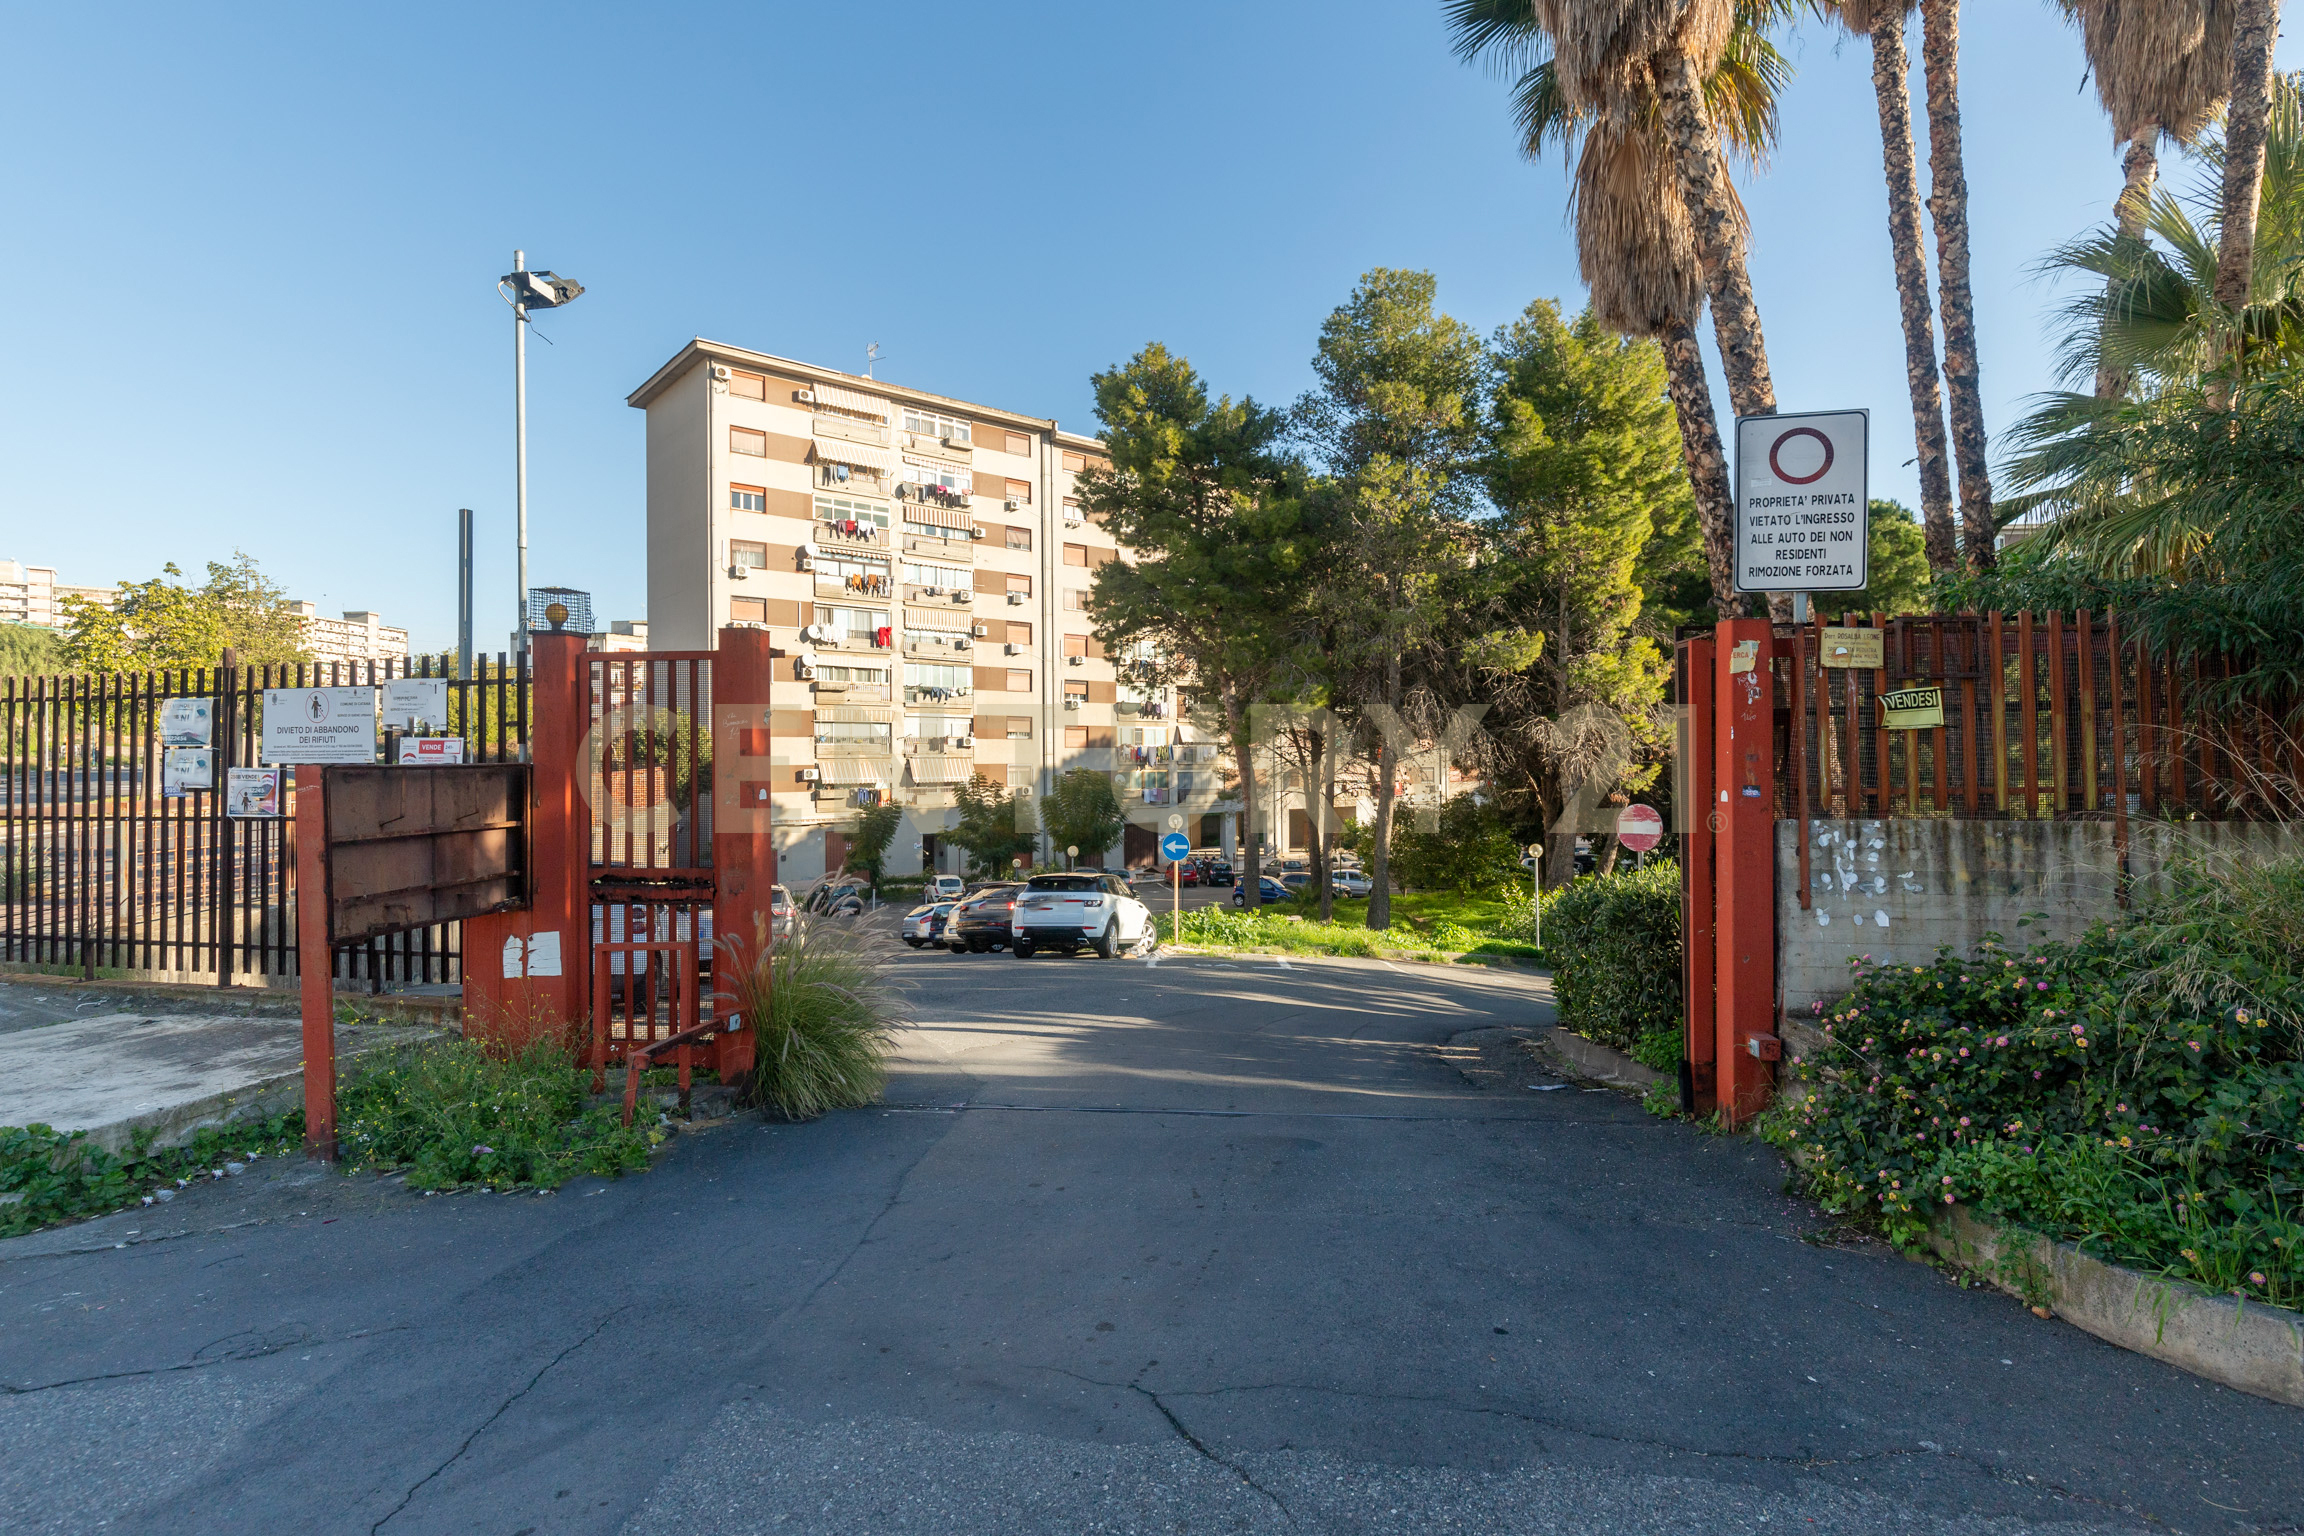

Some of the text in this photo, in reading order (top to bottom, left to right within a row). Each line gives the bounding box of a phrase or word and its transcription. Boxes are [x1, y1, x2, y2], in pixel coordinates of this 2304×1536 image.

[1749, 493, 1855, 508] PROPRIETA' PRIVATA
[1749, 512, 1855, 526] VIETATO L'INGRESSO
[1751, 531, 1853, 544] ALLE AUTO DEI NON
[1775, 548, 1826, 560] RESIDENTI
[1748, 565, 1853, 577] RIMOZIONE FORZATA
[1885, 691, 1937, 709] VENDESI
[277, 725, 359, 734] DIVIETO DI ABBANDONO
